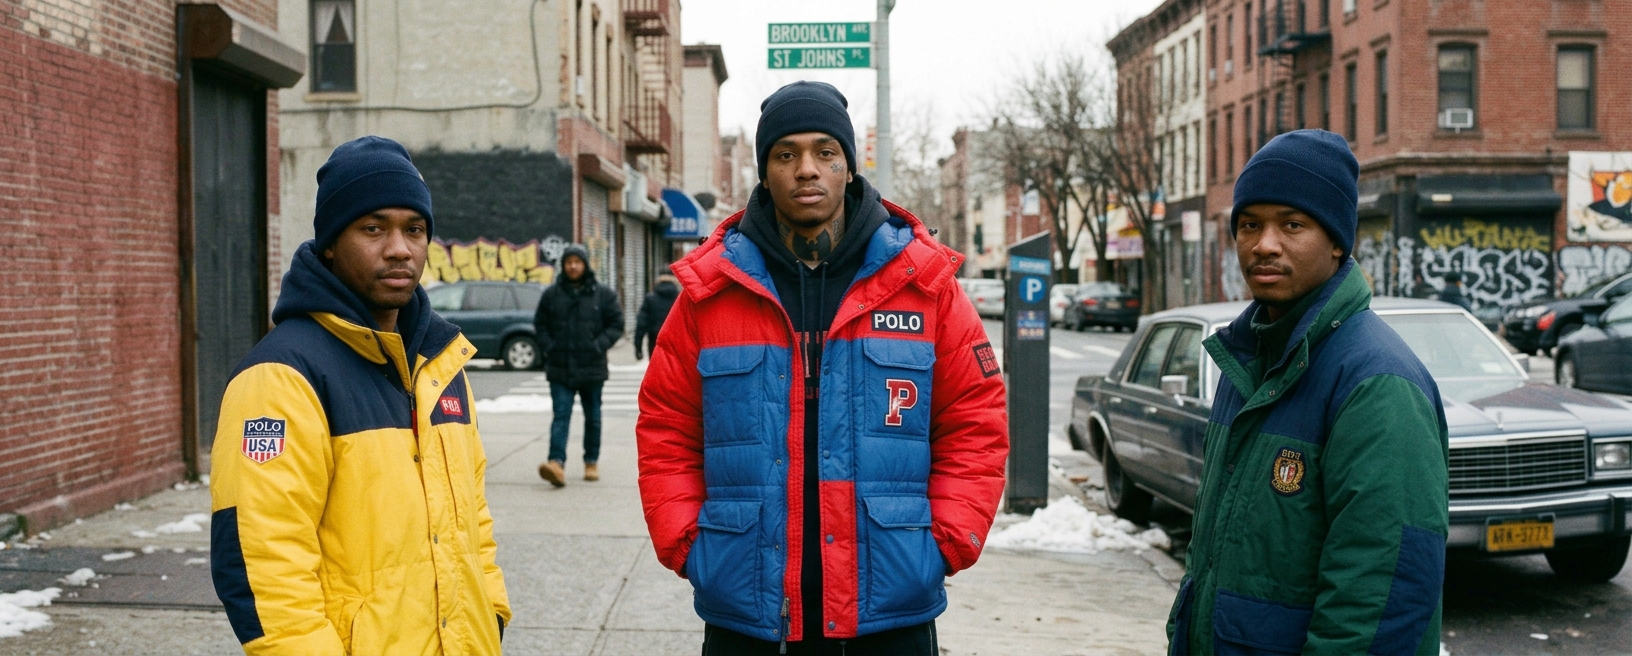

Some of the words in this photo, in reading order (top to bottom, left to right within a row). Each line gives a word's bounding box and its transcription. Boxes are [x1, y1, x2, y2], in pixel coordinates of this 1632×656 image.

[771, 24, 846, 43] BROOKLYN
[773, 49, 792, 68] ST
[797, 49, 846, 68] JOHNS
[1026, 278, 1043, 301] P
[874, 313, 921, 331] POLO
[885, 378, 918, 426] P
[247, 421, 282, 432] POLO
[248, 438, 277, 452] USA
